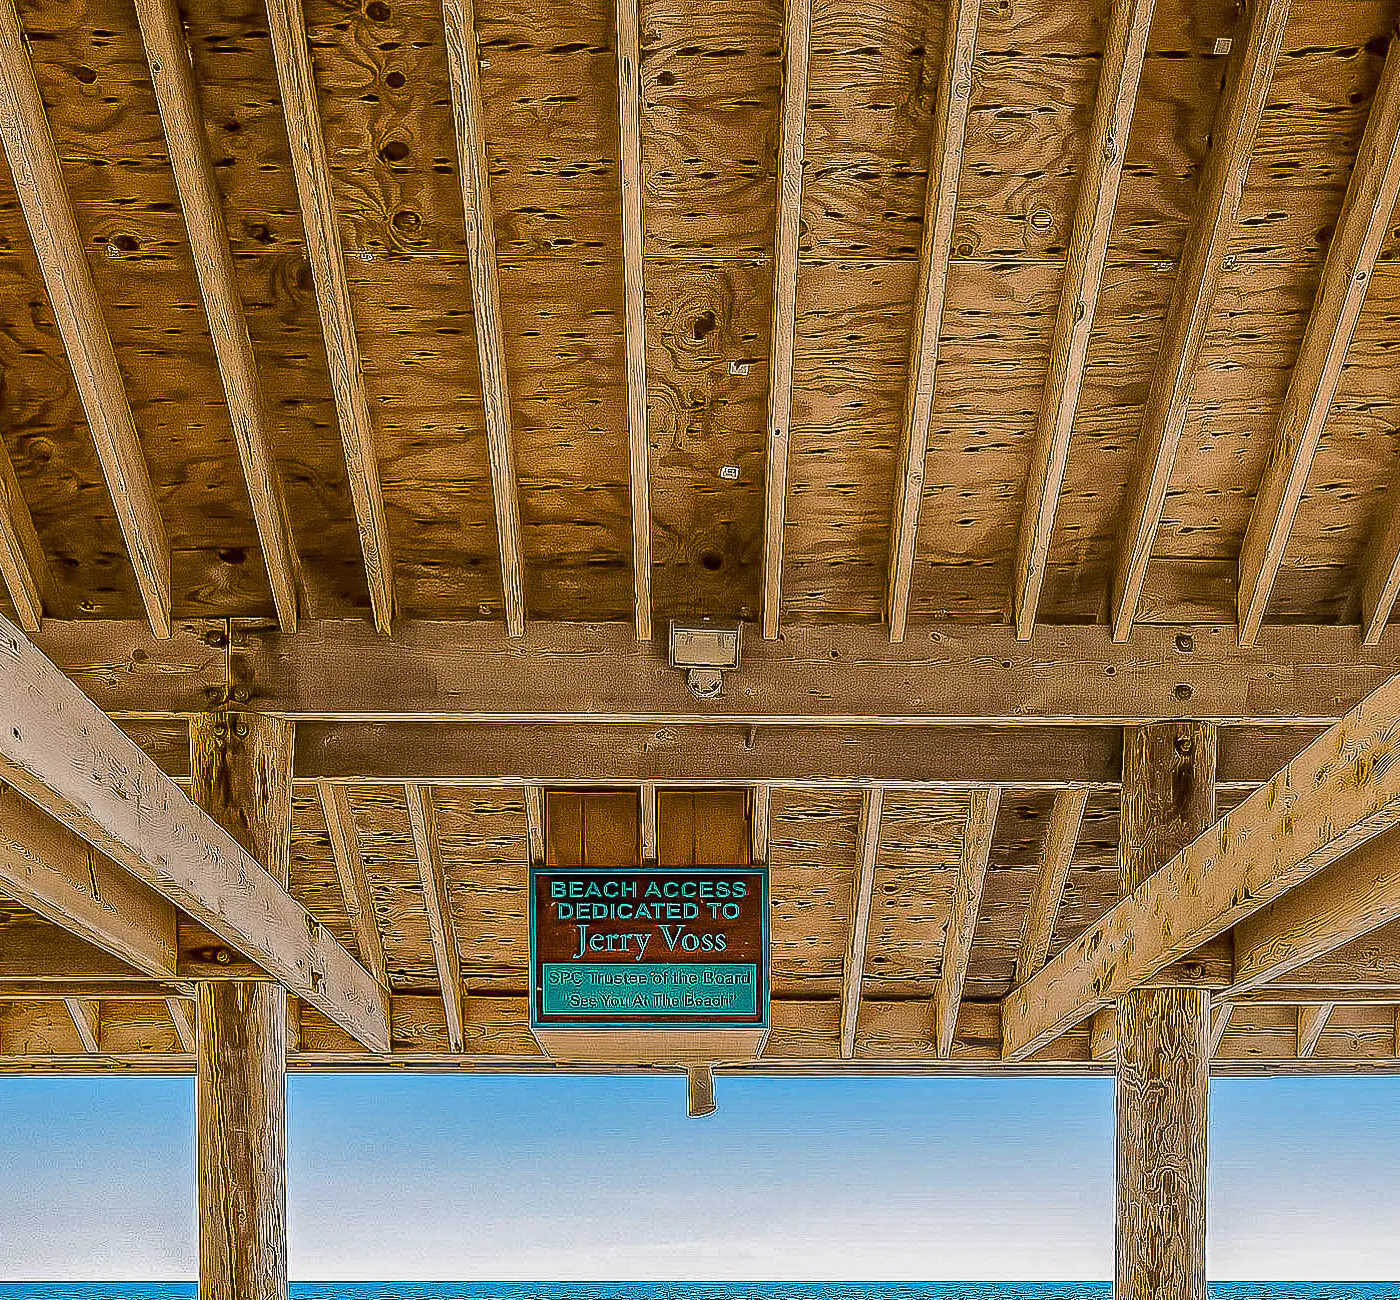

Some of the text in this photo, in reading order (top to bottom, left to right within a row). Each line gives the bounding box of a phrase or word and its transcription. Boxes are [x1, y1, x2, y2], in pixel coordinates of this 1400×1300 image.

[551, 881, 747, 898] BEACH ACCESS
[557, 902, 740, 920] DEDICATED TO
[572, 924, 727, 961] Jerry Voss
[549, 970, 751, 986] SPC Trustee of the Board
[601, 992, 629, 1007] You
[631, 992, 650, 1007] At
[652, 992, 679, 1007] The
